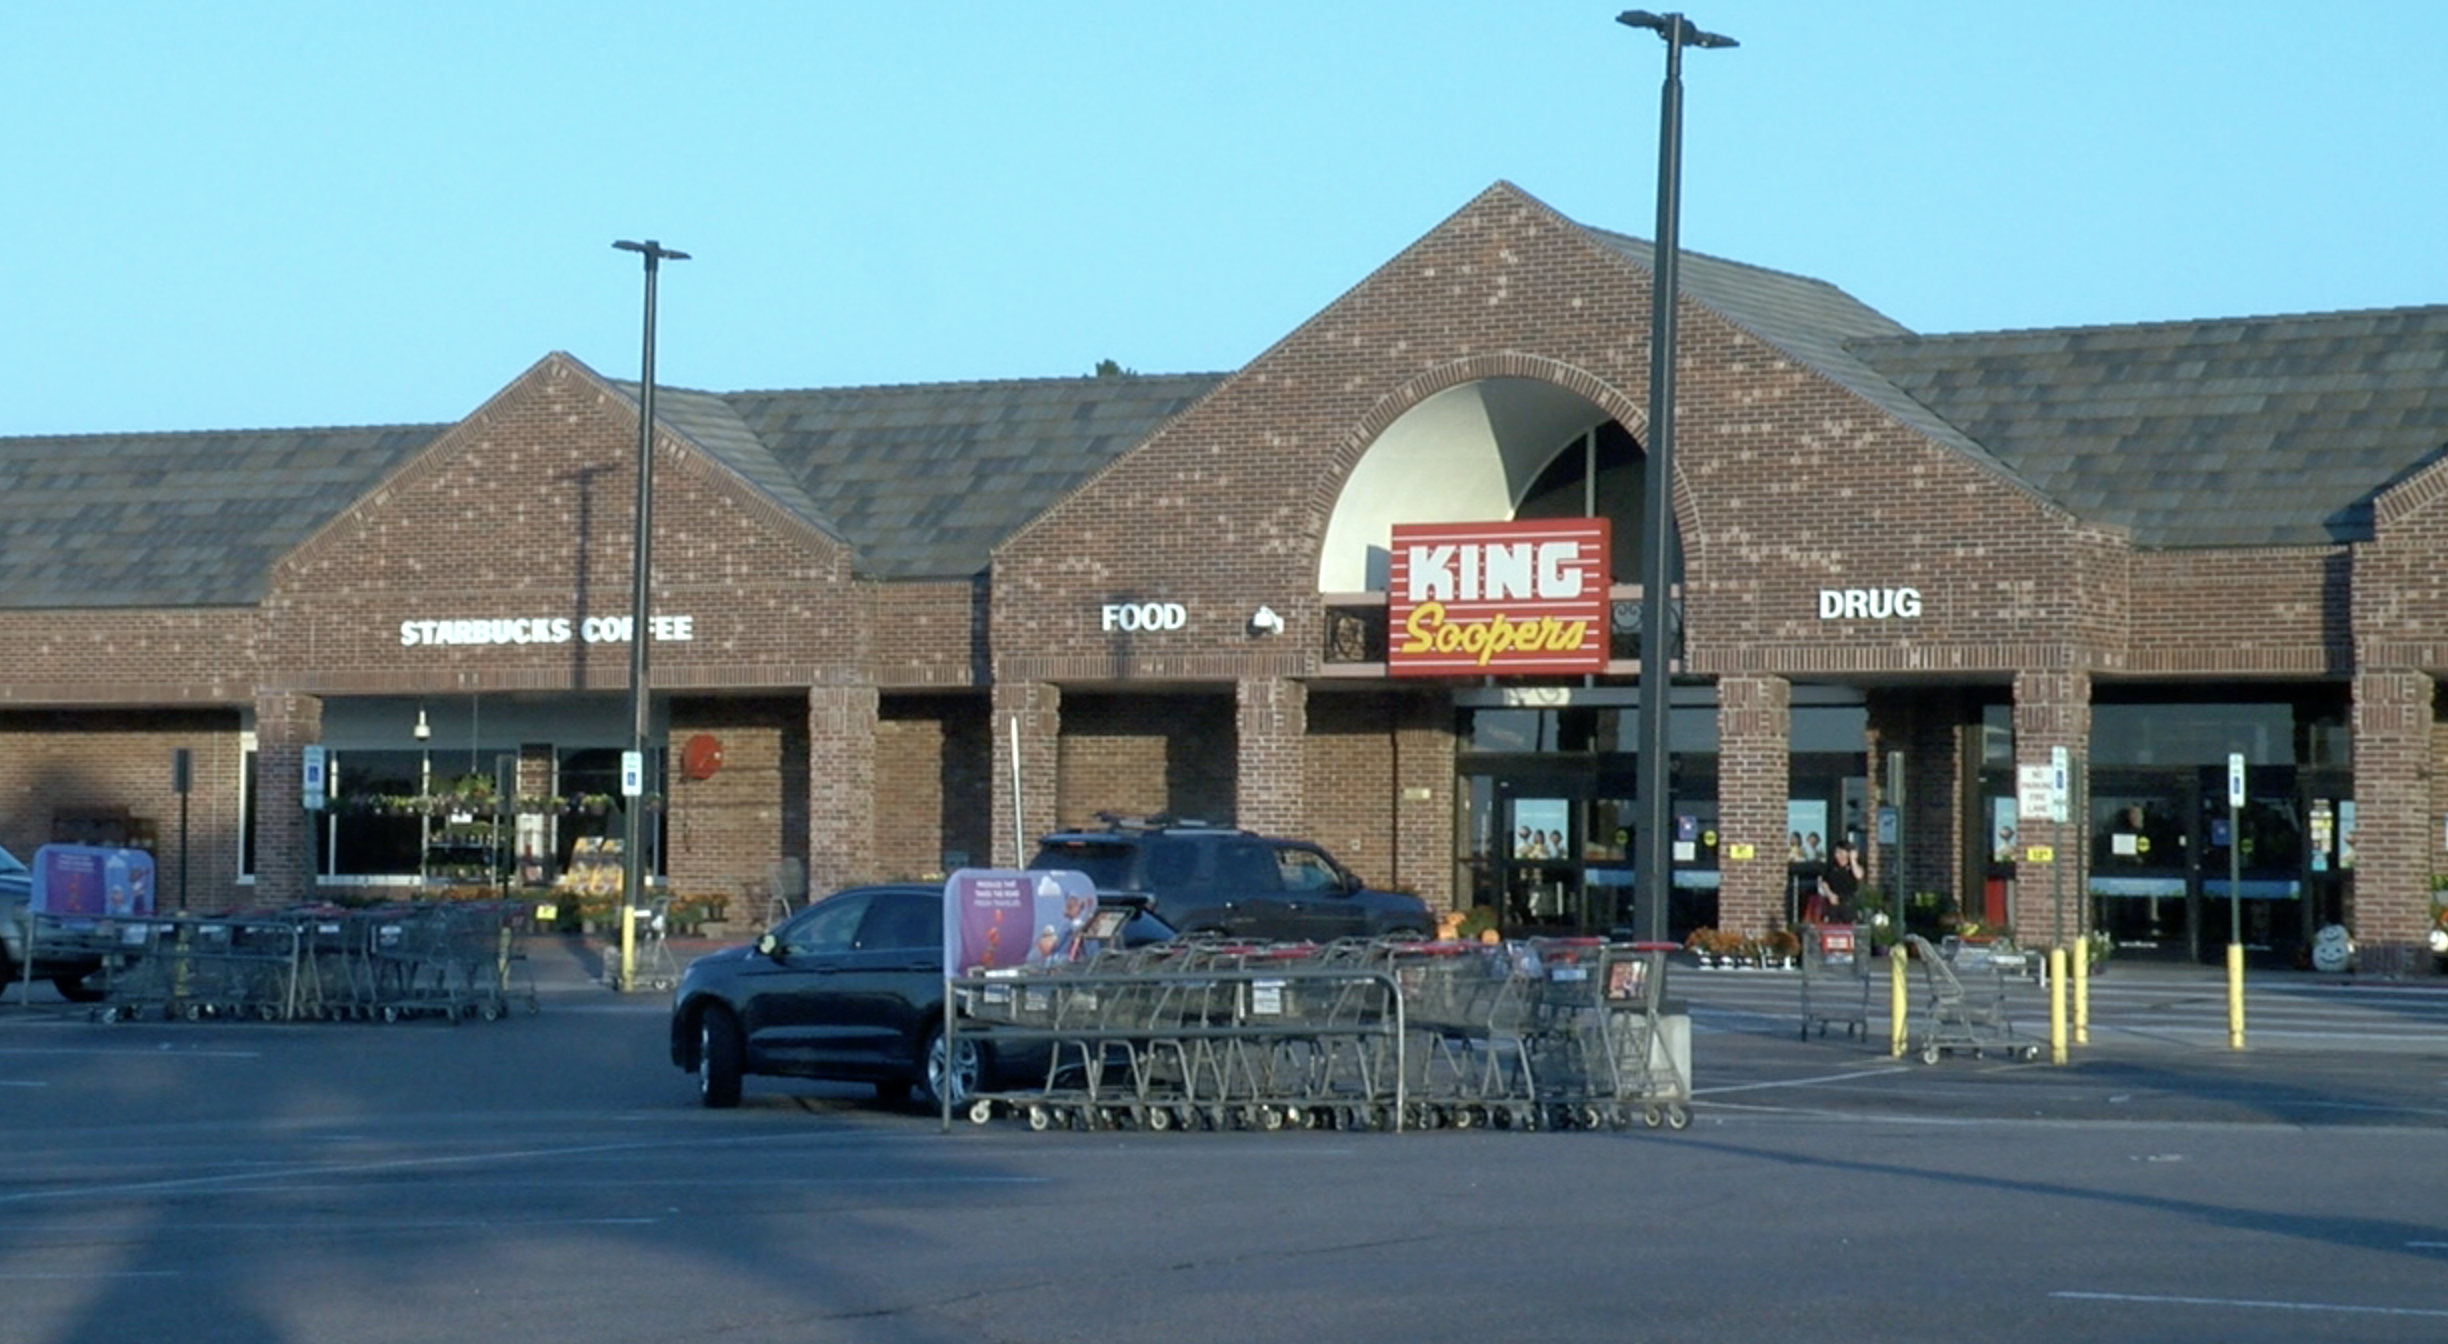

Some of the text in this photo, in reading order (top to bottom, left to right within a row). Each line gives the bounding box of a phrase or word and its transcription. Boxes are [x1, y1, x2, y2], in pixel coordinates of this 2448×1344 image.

[1408, 541, 1583, 601] KING
[1101, 602, 1187, 632] FOOD
[1819, 587, 1922, 619] DRUG
[400, 615, 693, 646] STARBUCKS COFEE
[1402, 601, 1587, 666] Soopers
